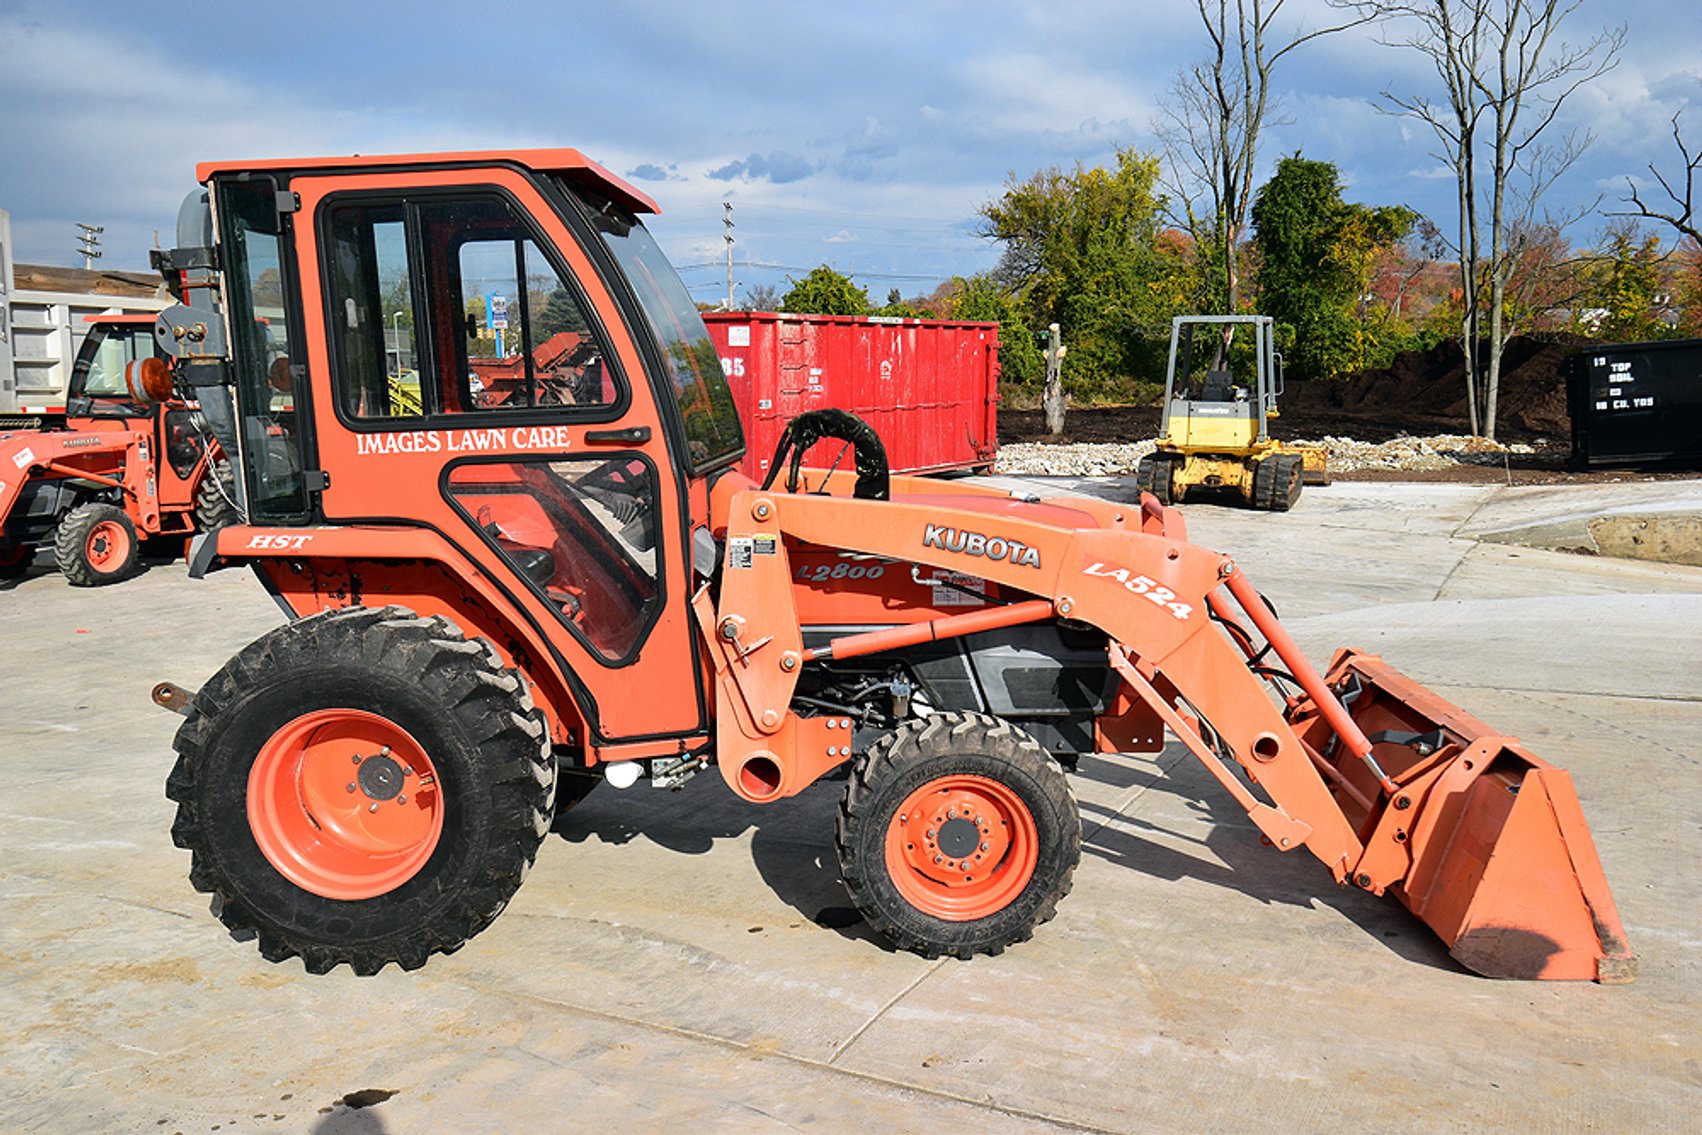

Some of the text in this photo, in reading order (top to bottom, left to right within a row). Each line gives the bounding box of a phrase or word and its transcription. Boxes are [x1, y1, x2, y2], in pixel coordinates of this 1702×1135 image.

[1610, 362, 1632, 372] TOP
[63, 437, 101, 448] KUBOTA
[356, 426, 571, 455] IMAGES LAWN CARE
[245, 535, 314, 549] HST
[923, 523, 1041, 569] KUBOTA
[796, 562, 885, 583] L2800
[1082, 562, 1194, 620] LA524
